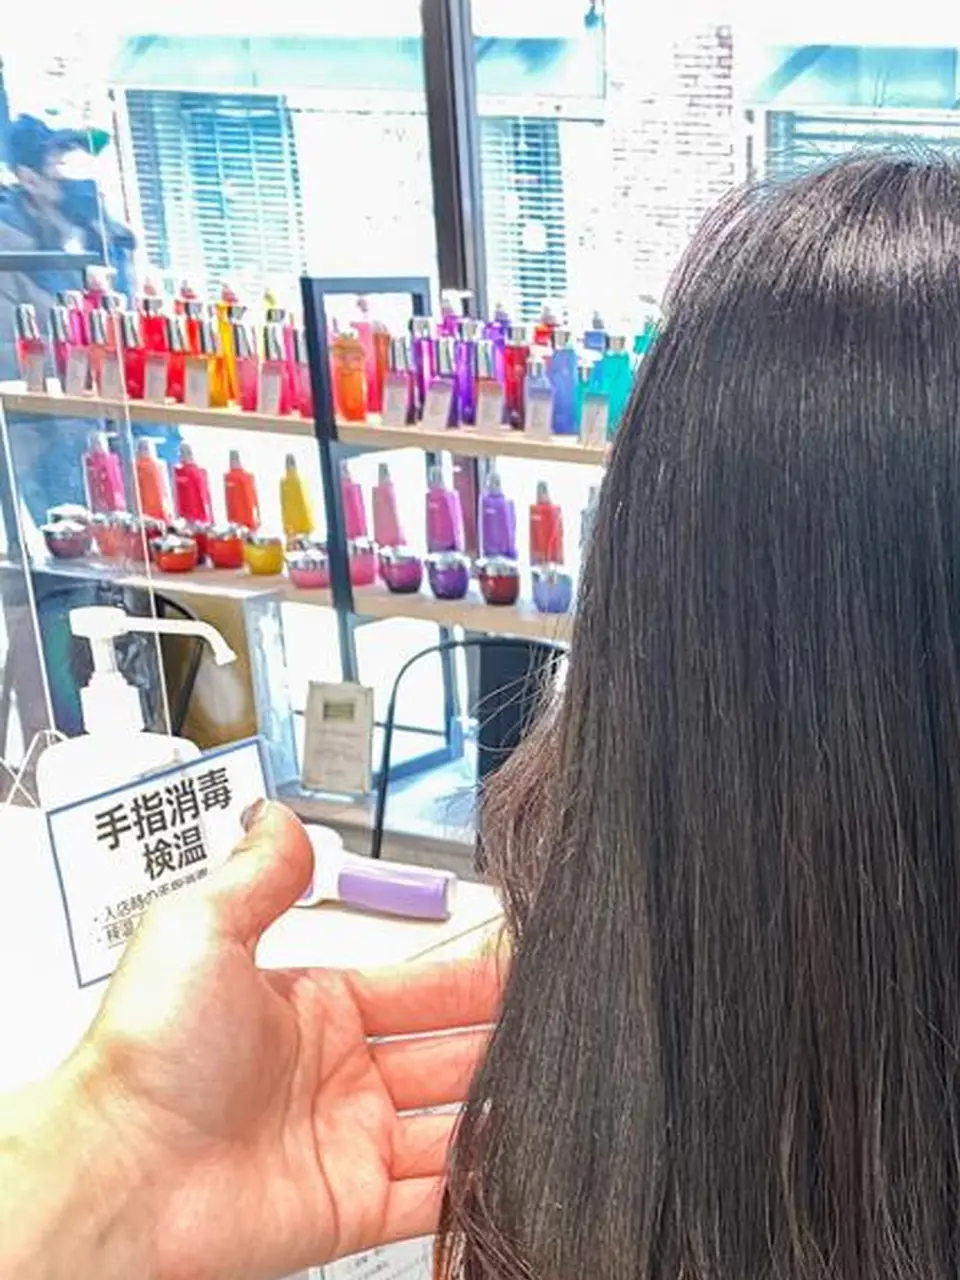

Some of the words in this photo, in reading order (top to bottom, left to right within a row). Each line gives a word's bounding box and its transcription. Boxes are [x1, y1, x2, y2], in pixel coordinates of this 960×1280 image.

[95, 767, 233, 850] 手指消毒
[143, 825, 208, 880] 検温
